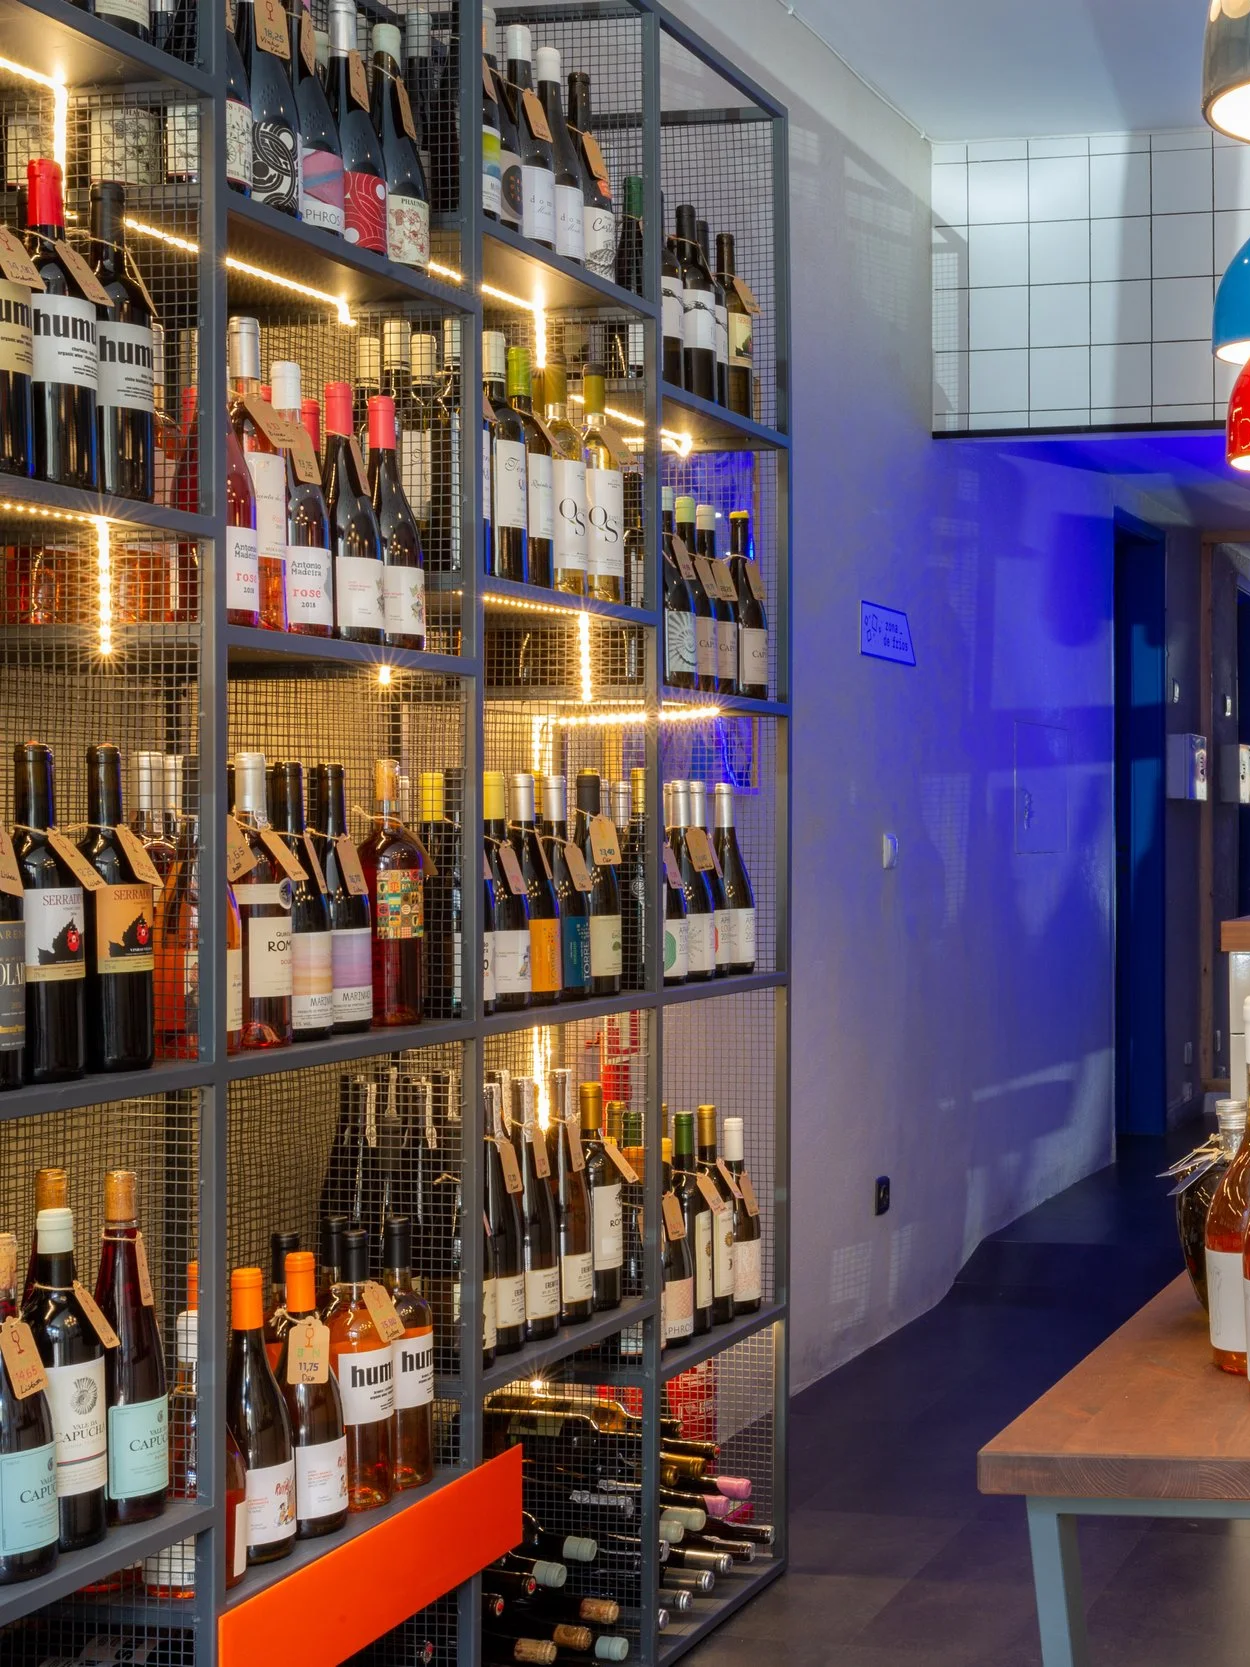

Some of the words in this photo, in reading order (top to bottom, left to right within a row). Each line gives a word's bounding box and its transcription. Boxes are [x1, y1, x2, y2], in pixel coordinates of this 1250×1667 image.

[291, 560, 321, 570] Antonio
[291, 567, 321, 577] Madeira
[293, 586, 321, 598] rosé
[298, 1362, 319, 1373] 11,75
